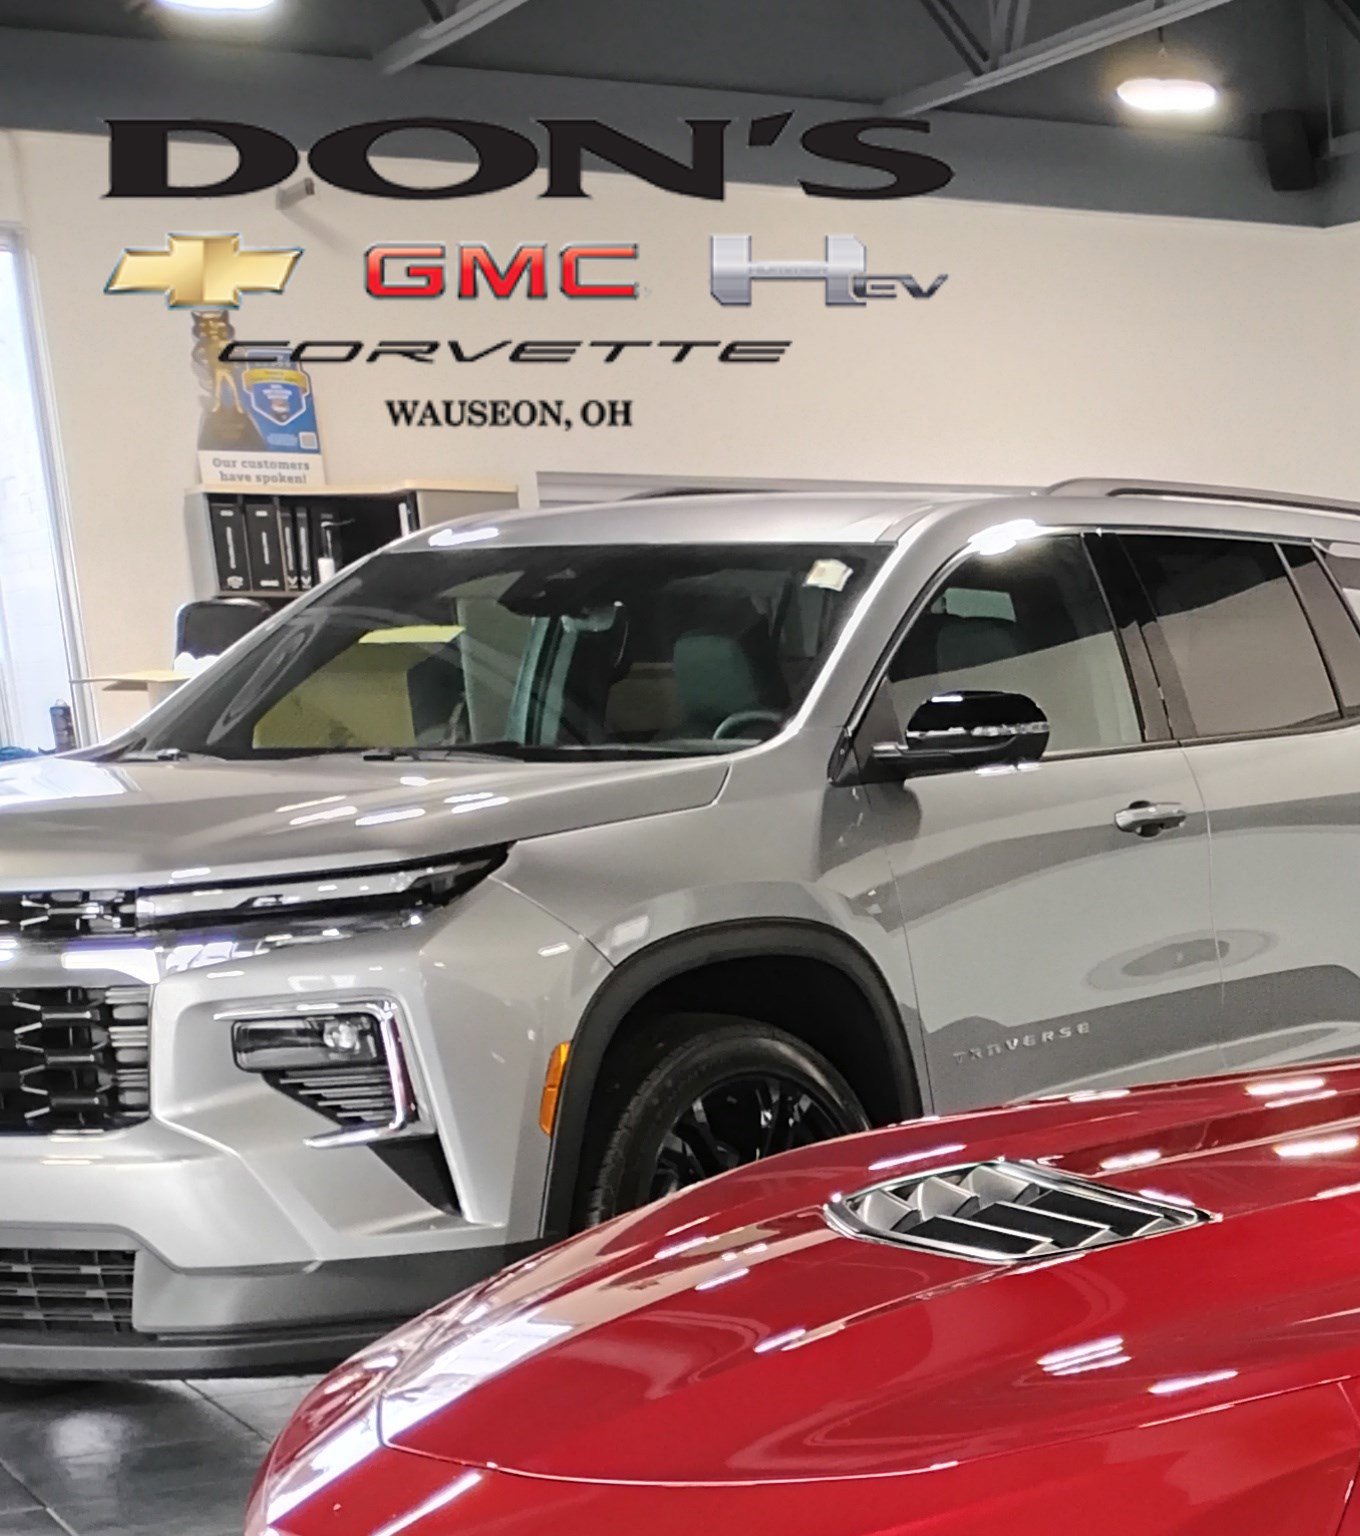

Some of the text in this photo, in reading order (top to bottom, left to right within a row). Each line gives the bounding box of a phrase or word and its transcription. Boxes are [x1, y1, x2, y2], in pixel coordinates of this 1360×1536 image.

[212, 457, 310, 471] Our customers
[219, 470, 307, 485] have spoken!
